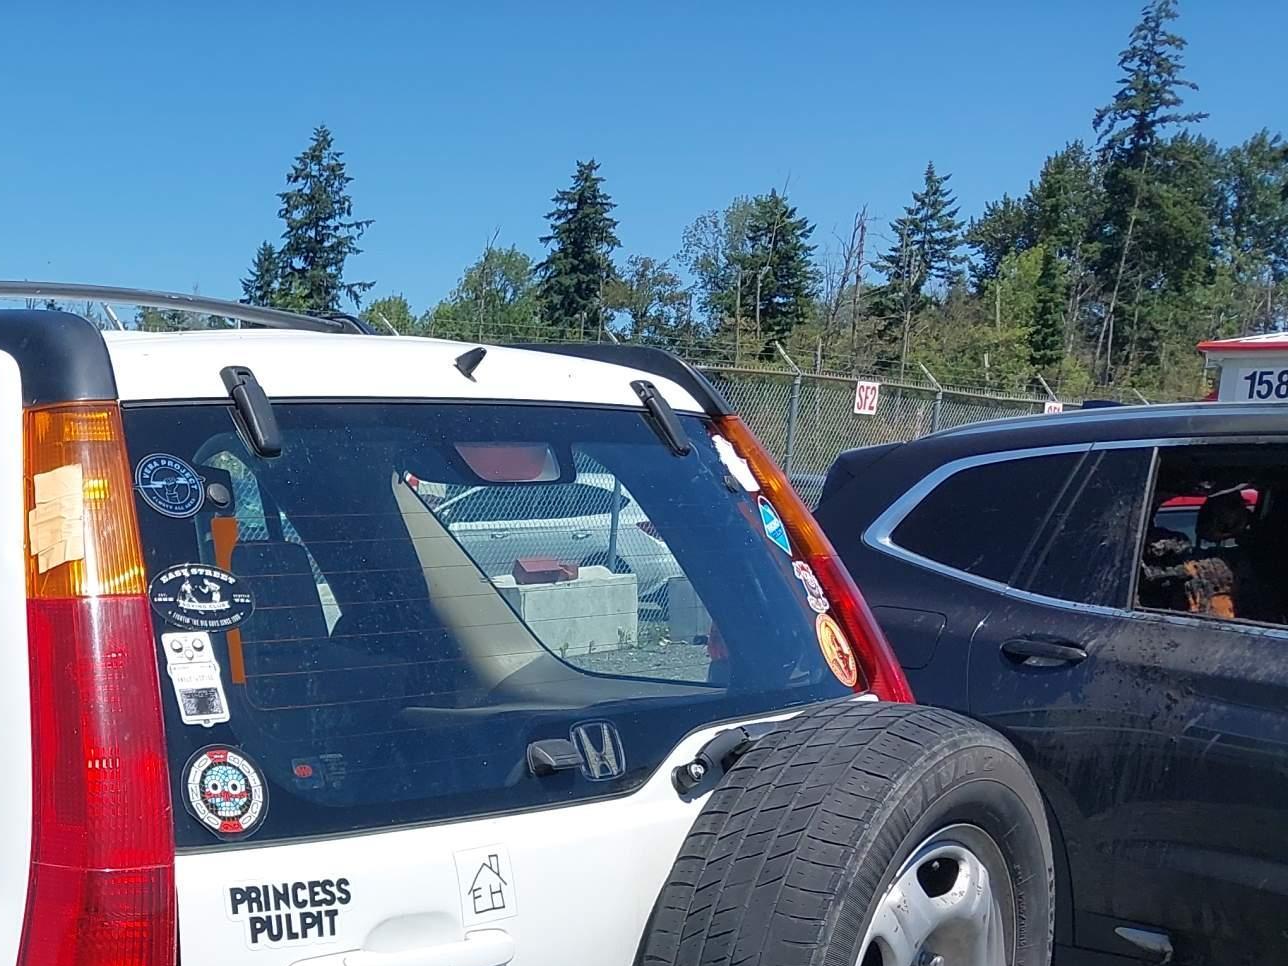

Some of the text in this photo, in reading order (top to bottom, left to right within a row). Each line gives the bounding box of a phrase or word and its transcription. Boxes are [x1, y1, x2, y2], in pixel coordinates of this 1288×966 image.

[857, 384, 878, 412] SF2
[1244, 369, 1288, 399] 158
[142, 459, 198, 491] VERA PROJECT
[160, 568, 236, 585] EASY STREET
[229, 878, 351, 914] PRINCESS
[249, 909, 339, 944] PULPIT
